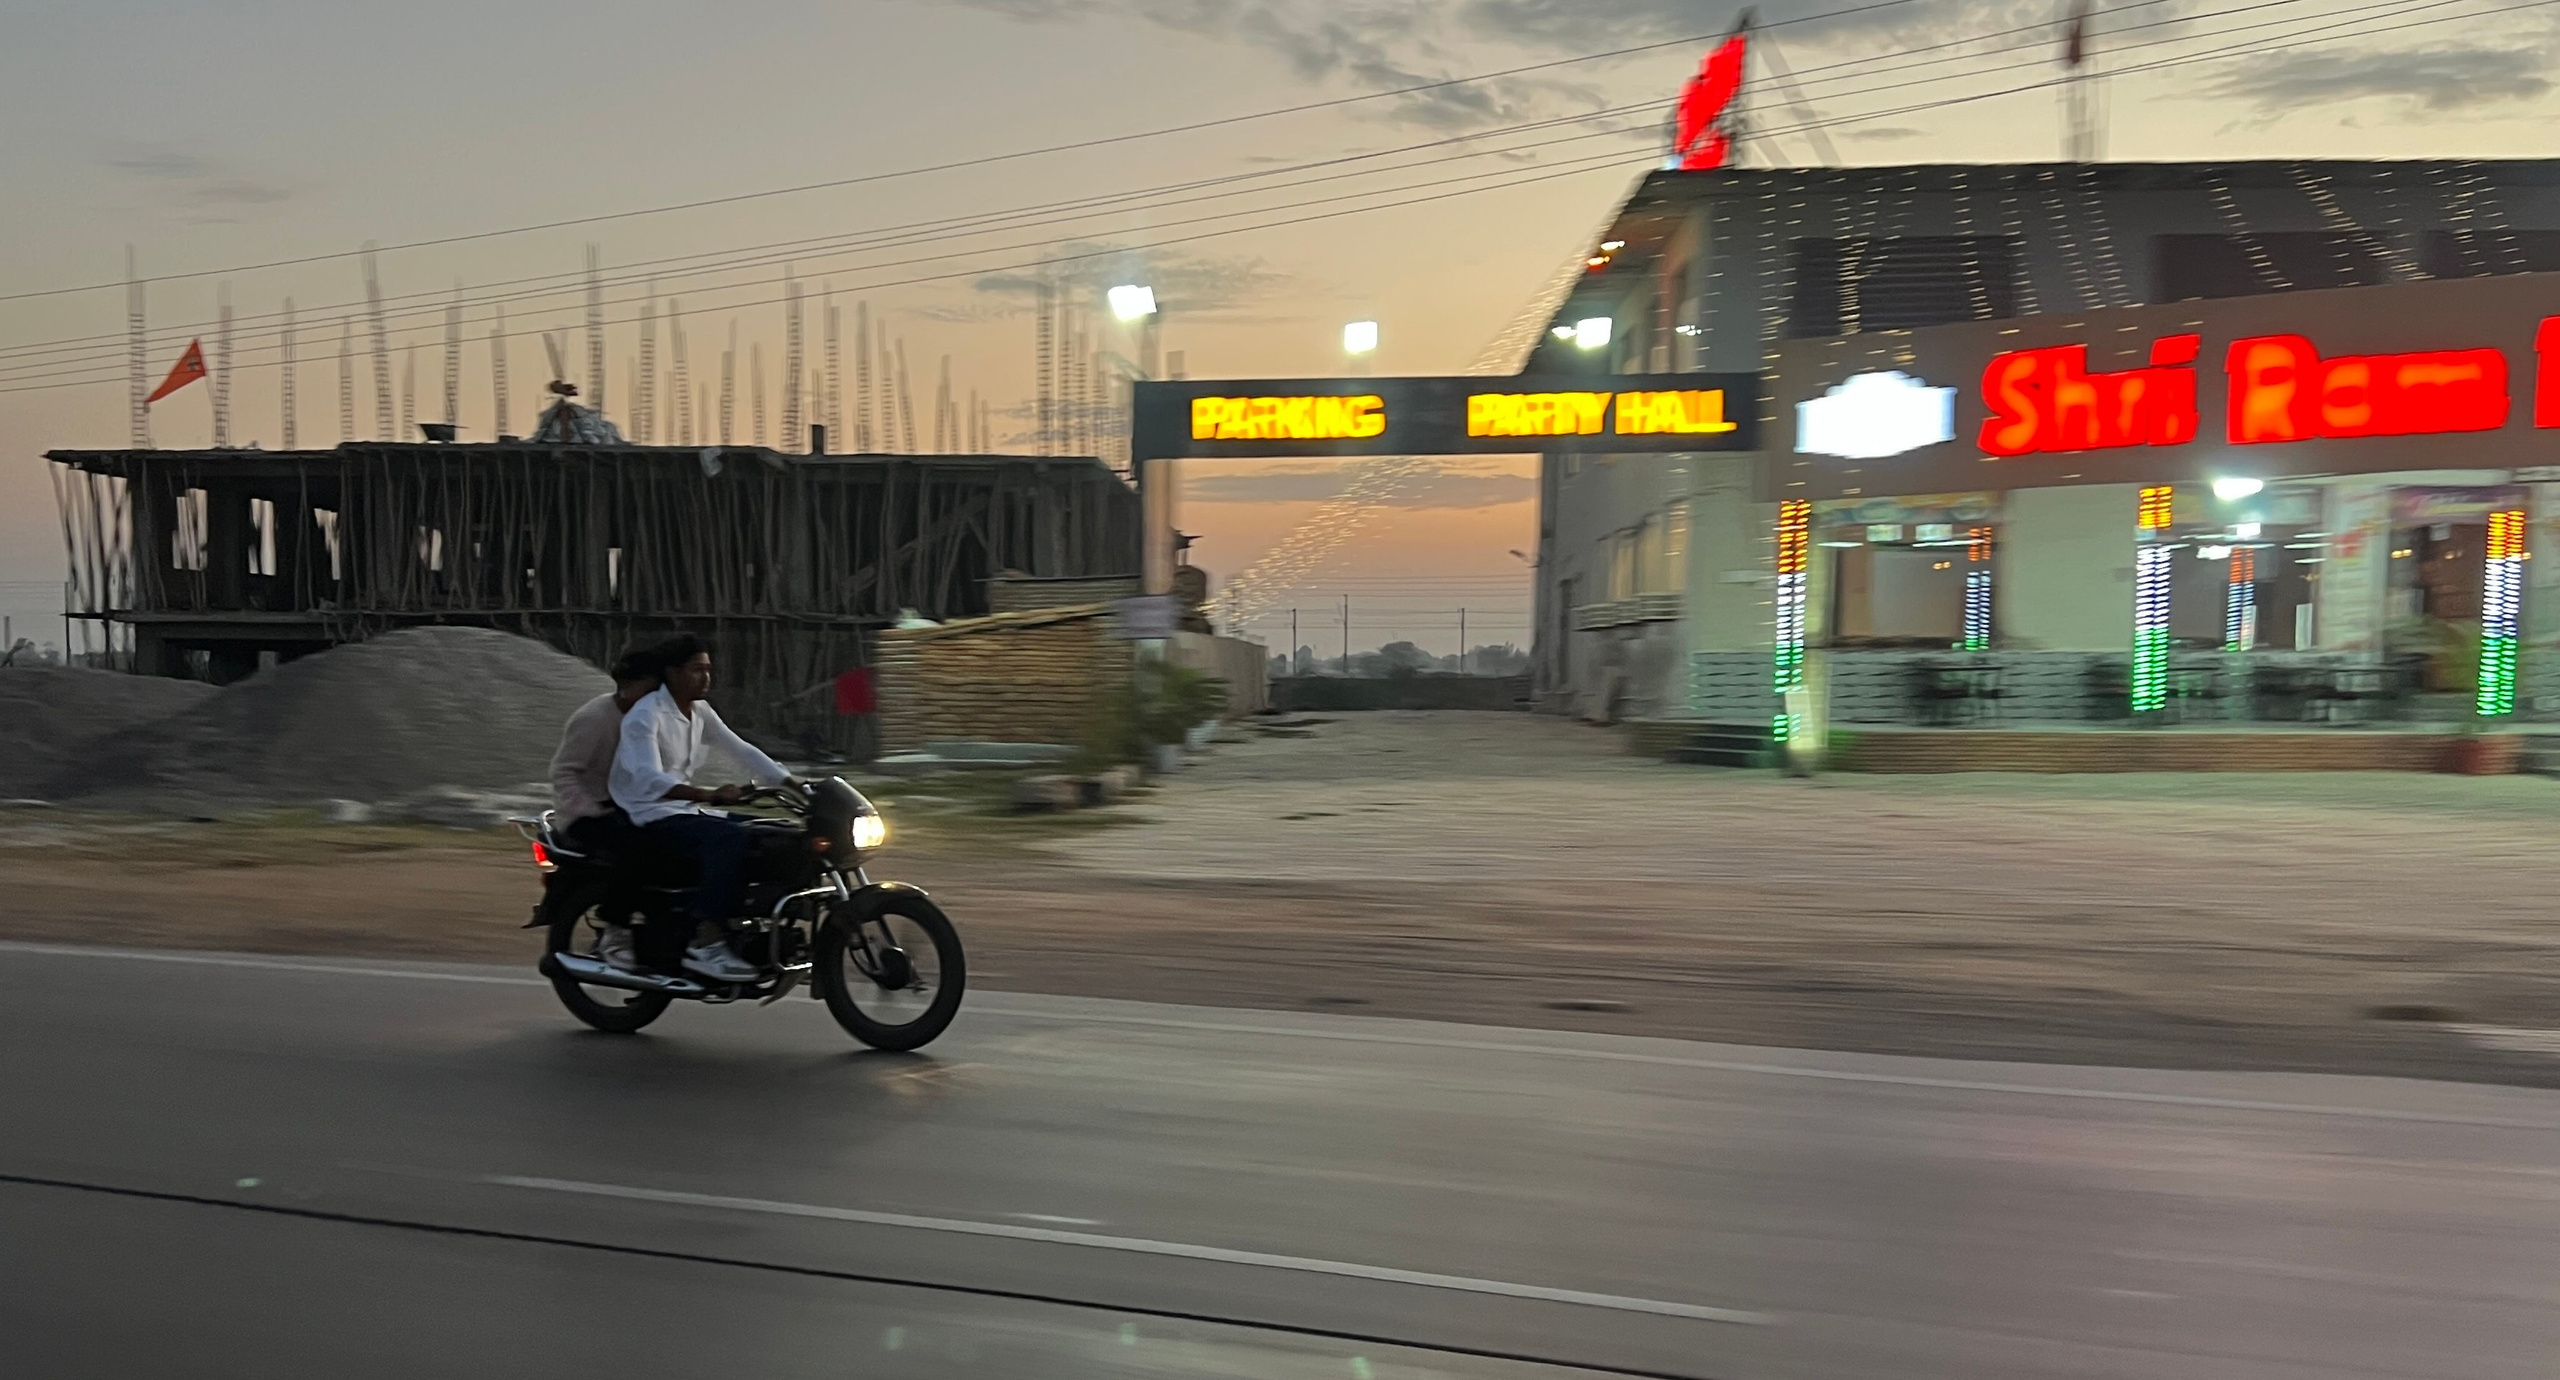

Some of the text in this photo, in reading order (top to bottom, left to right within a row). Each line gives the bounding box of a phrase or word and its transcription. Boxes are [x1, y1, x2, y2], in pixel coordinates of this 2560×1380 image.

[1191, 395, 1387, 440] PARKING
[1467, 389, 1737, 437] PARTY HALL
[1977, 333, 2201, 457] Shri
